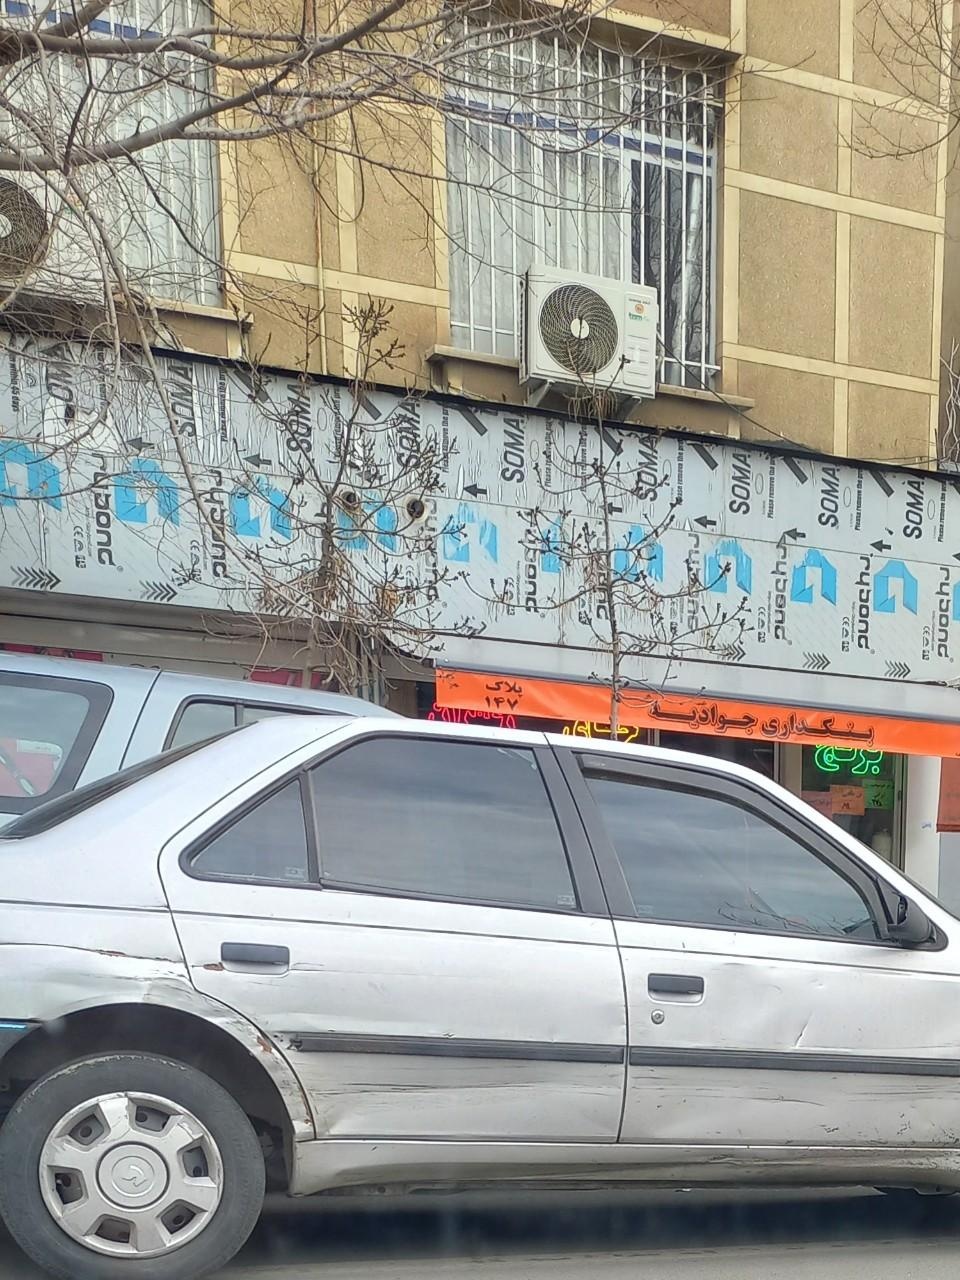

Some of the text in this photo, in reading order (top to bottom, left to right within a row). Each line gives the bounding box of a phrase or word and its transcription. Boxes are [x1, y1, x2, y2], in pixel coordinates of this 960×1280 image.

[168, 366, 197, 437] SOMA
[501, 417, 525, 484] SOMA
[637, 435, 658, 502] SOMA
[729, 453, 752, 515] SOMA
[818, 467, 840, 528] SOMA
[902, 479, 925, 540] SOMA
[485, 680, 523, 697] پلاک
[761, 713, 875, 746] بنکداری
